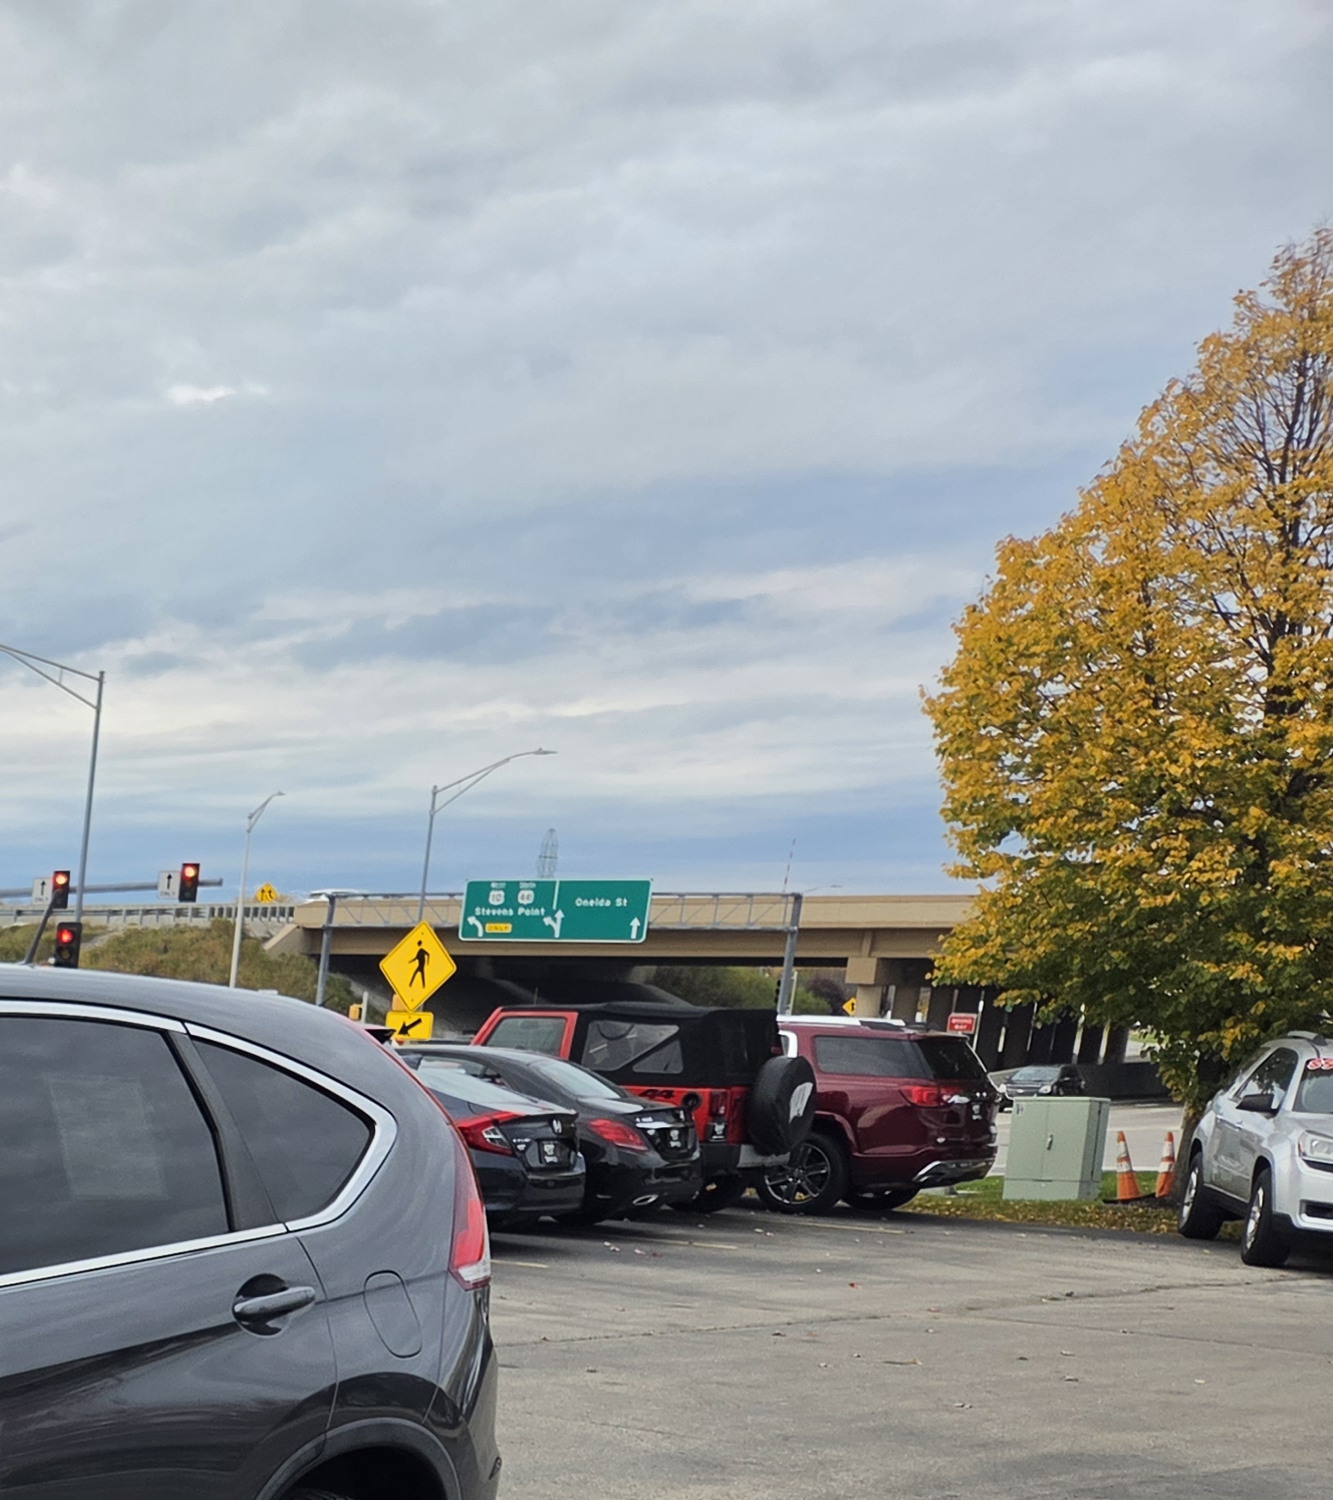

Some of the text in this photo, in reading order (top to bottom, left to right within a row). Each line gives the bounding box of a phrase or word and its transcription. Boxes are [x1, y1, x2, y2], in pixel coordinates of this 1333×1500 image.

[575, 897, 628, 907] Oneida St
[474, 907, 546, 916] Stevens Point
